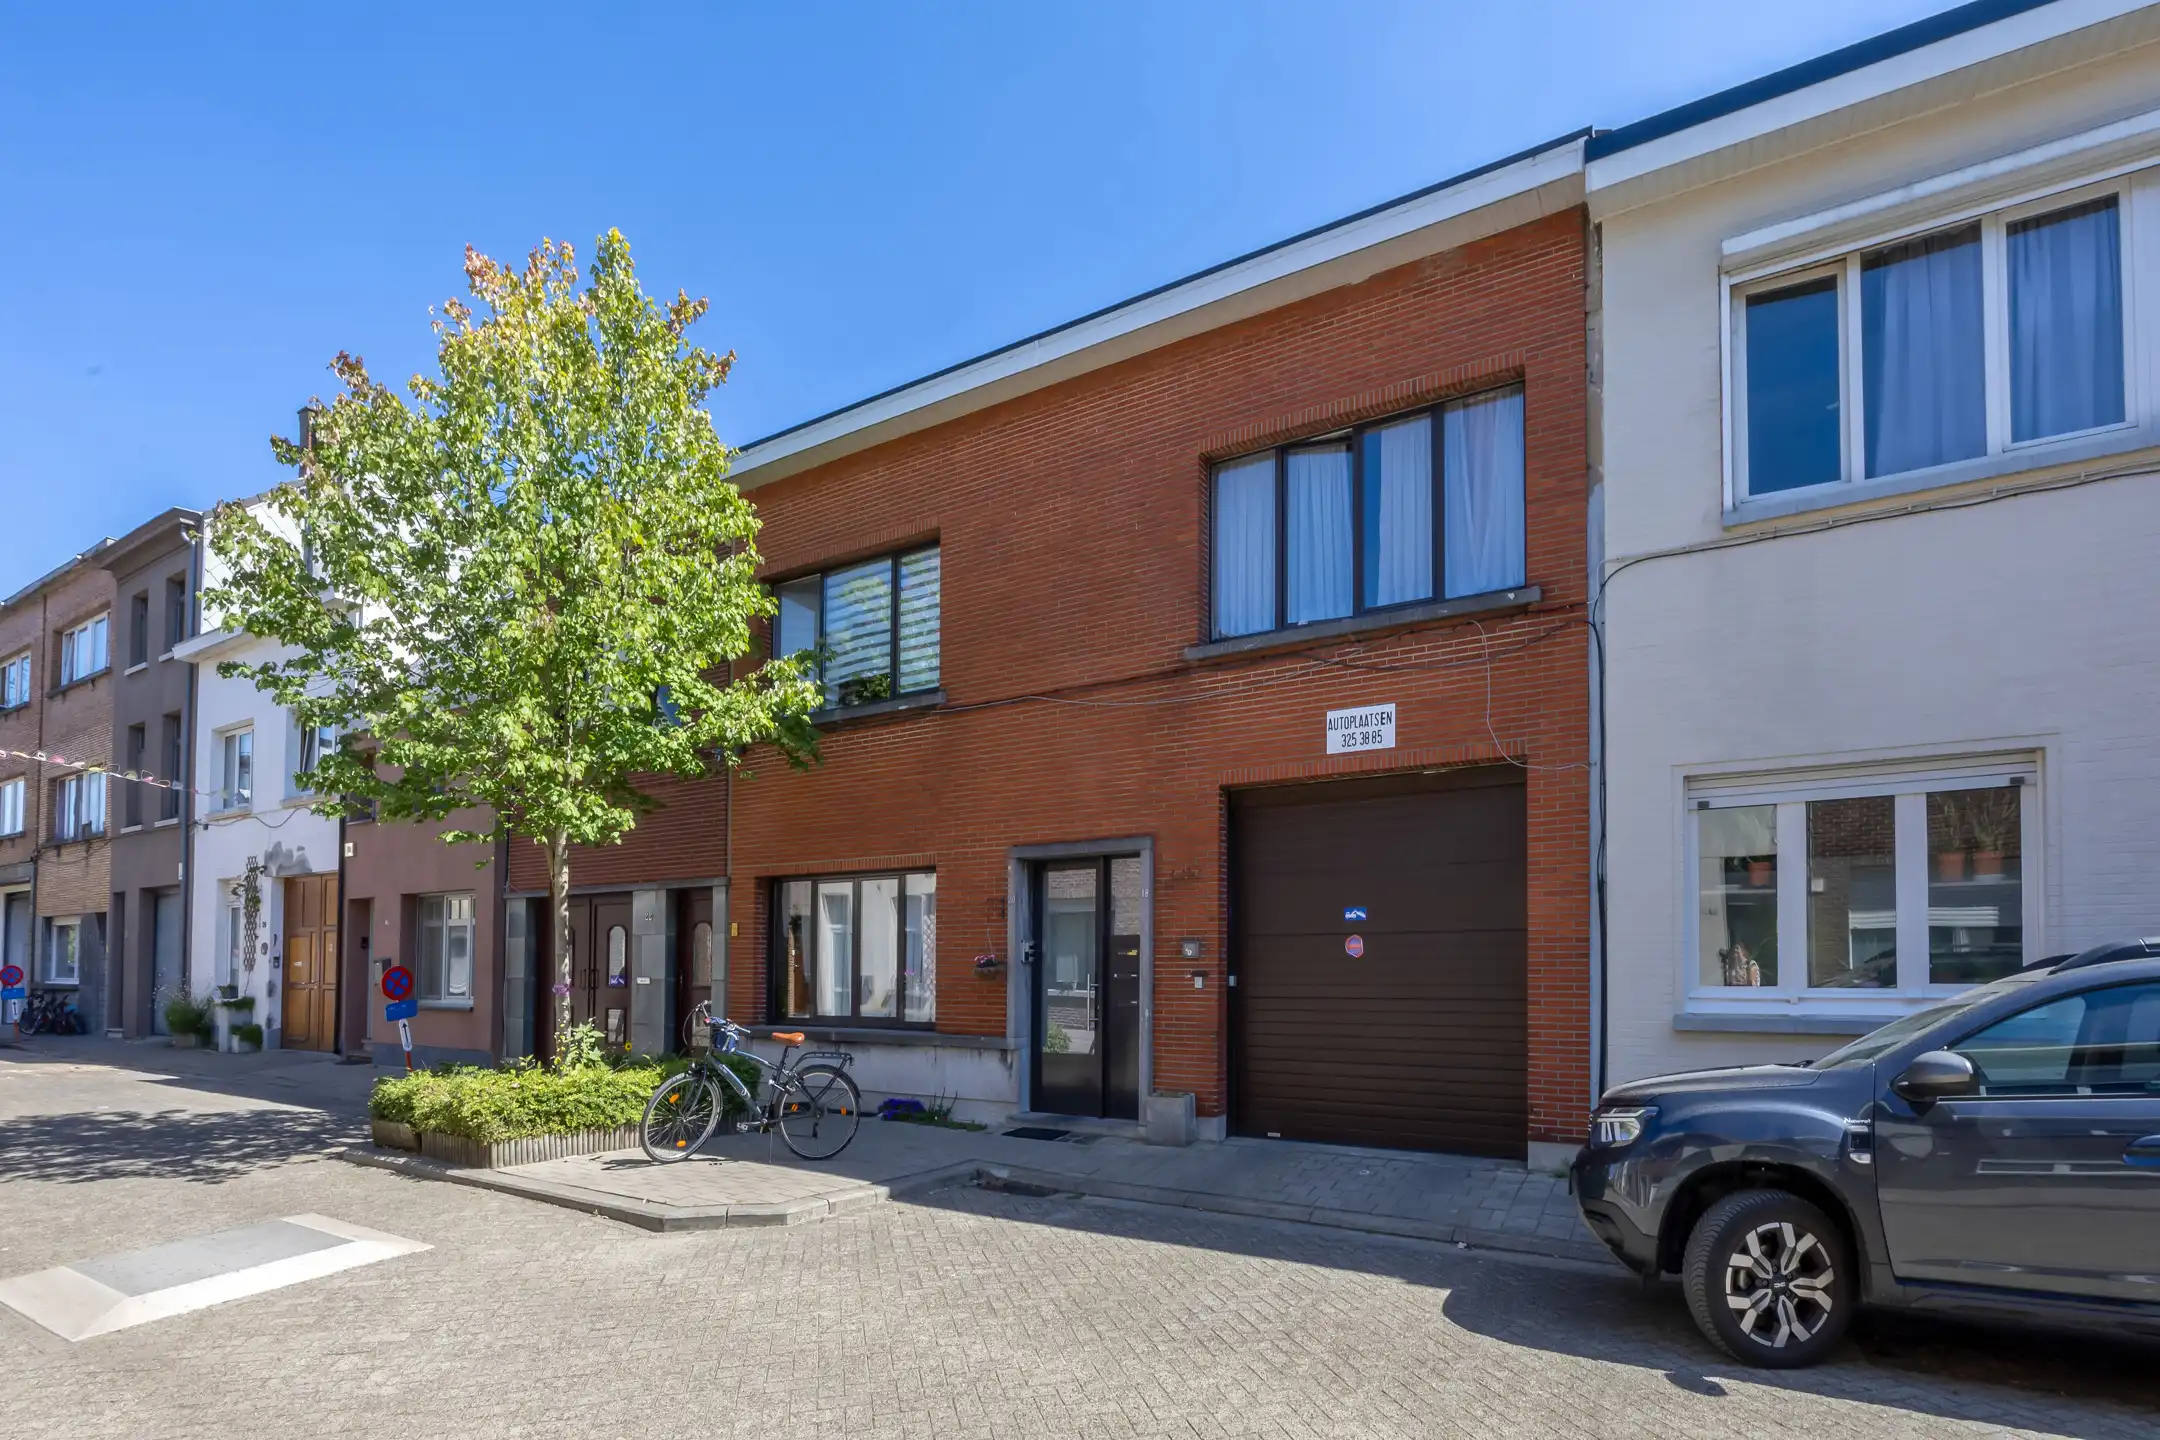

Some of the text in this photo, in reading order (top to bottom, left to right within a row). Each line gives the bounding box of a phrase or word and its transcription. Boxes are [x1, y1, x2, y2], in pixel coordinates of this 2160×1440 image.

[1328, 711, 1392, 731] AUTOPLAATSEN
[1341, 729, 1383, 748] 325 38 85
